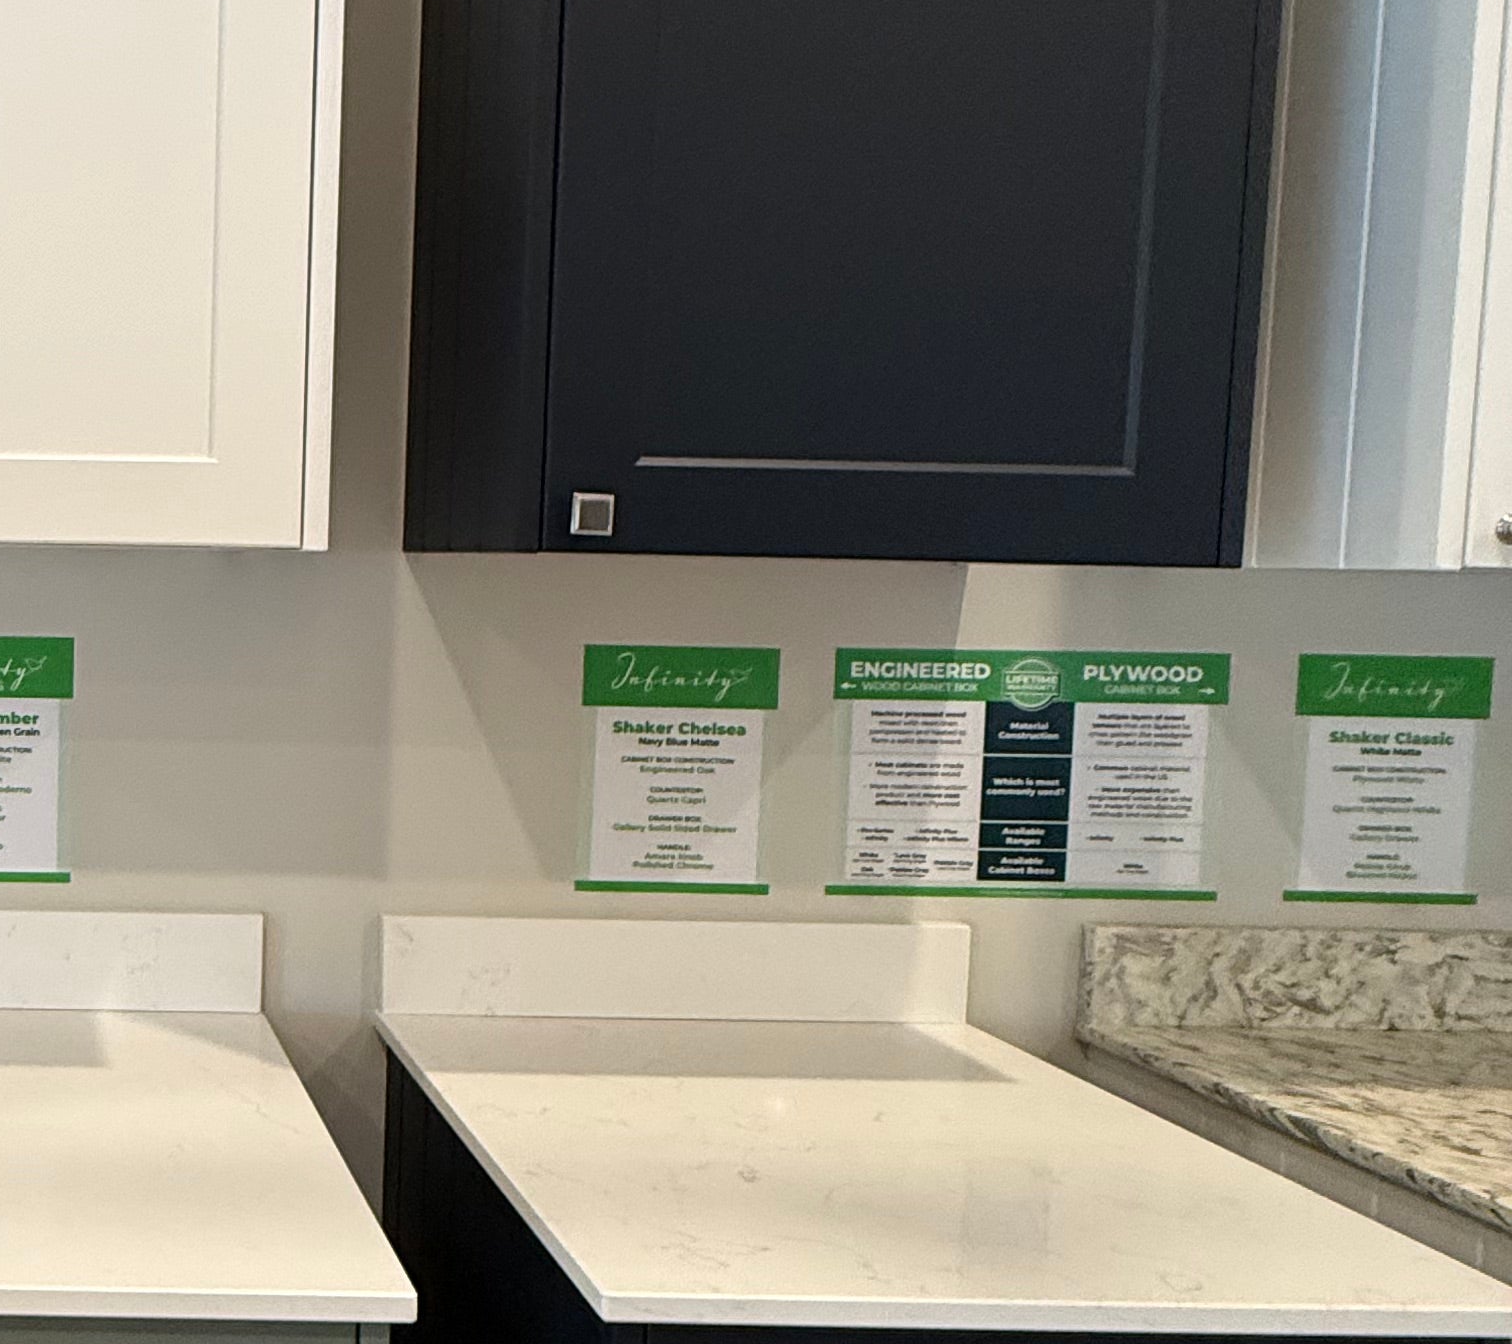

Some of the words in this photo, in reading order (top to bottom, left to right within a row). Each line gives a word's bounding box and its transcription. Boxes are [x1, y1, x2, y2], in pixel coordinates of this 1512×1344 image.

[850, 661, 991, 679] ENGINEERED
[1083, 664, 1204, 683] PLYWOOD
[611, 652, 731, 702] Infinity
[1005, 675, 1058, 684] LIFETIME
[861, 682, 897, 691] WOOD
[903, 682, 950, 692] CABINET
[953, 683, 979, 692] BOX
[1324, 662, 1444, 712] Infinity
[14, 728, 40, 736] Grain
[613, 720, 674, 734] Shaker
[678, 722, 746, 736] Chelsea
[1010, 722, 1049, 730] Material
[998, 731, 1060, 740] Construction
[1328, 731, 1390, 744] Shaker
[1395, 731, 1455, 746] Classic
[638, 737, 663, 747] Navy
[666, 738, 688, 746] Blue
[690, 738, 720, 746] Matte
